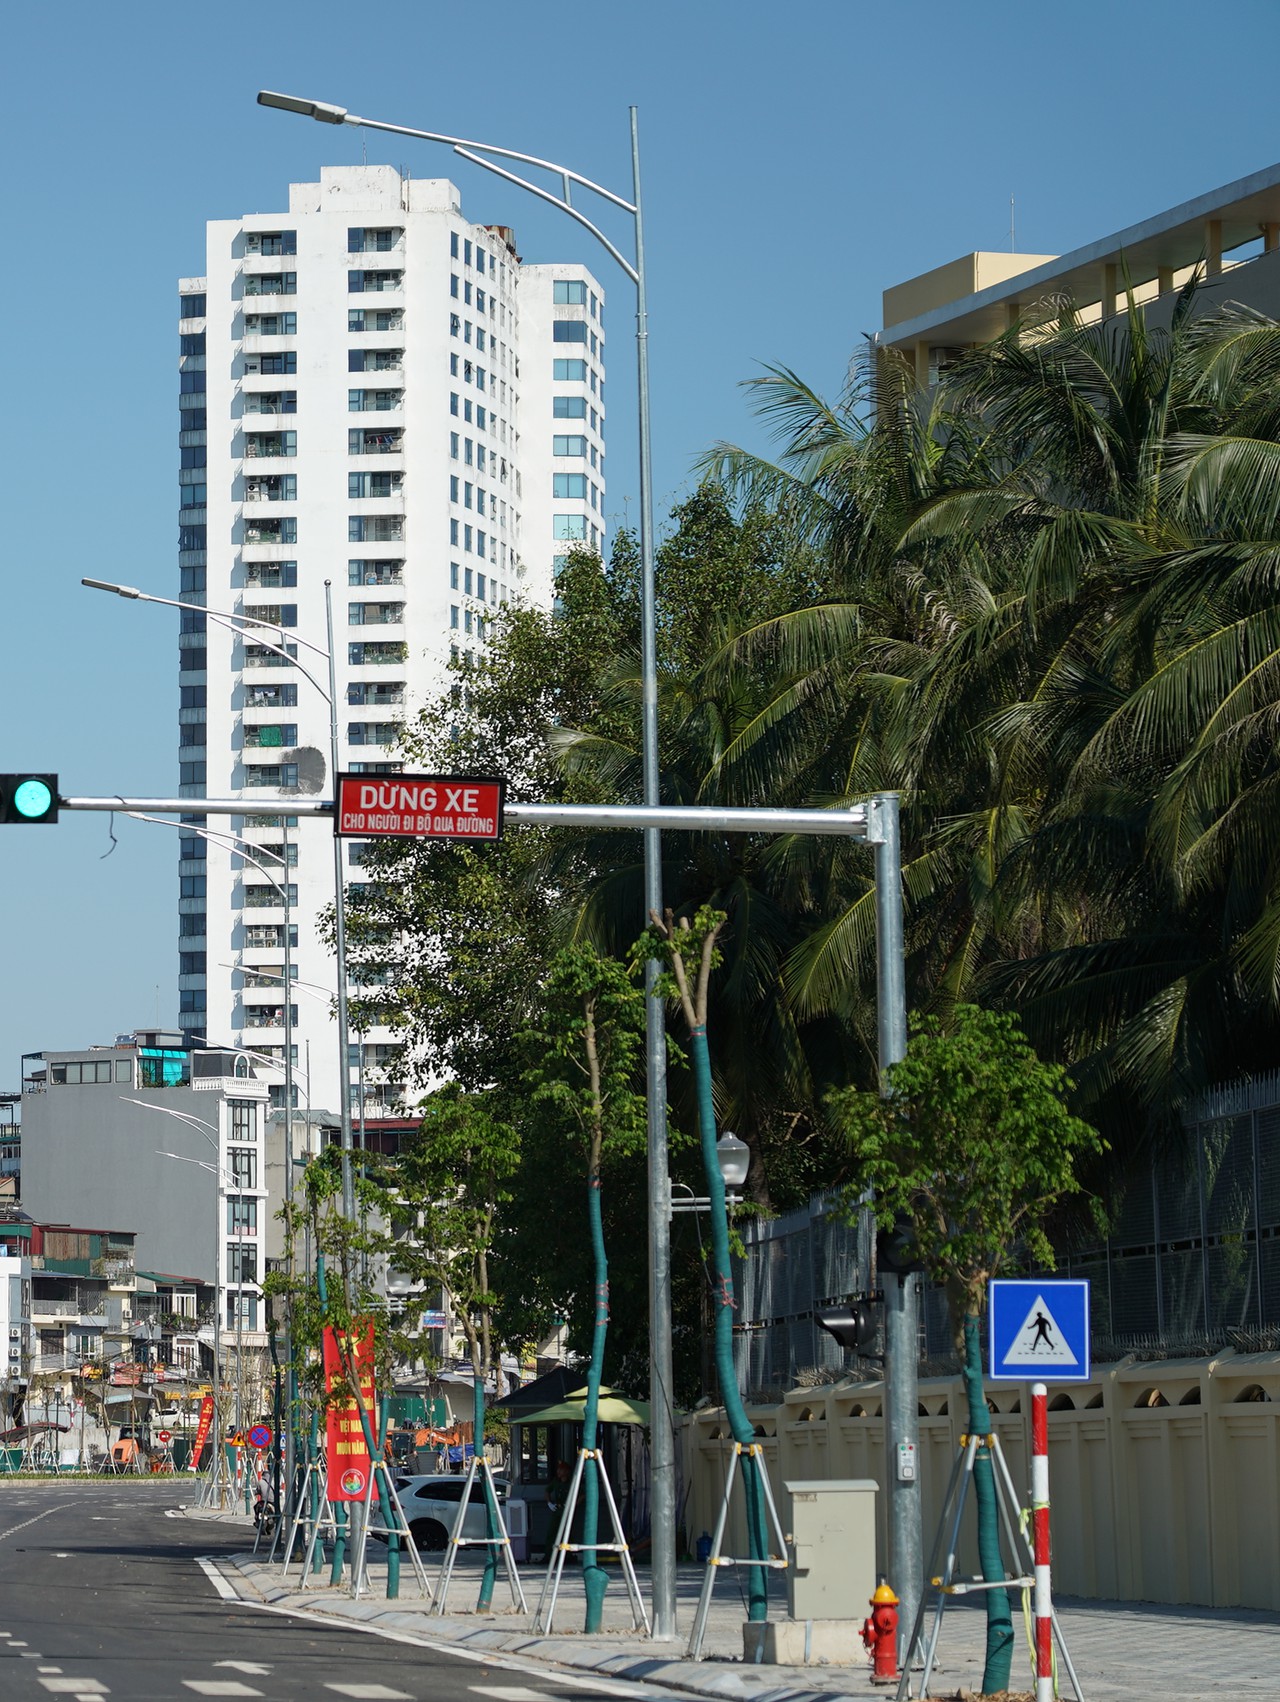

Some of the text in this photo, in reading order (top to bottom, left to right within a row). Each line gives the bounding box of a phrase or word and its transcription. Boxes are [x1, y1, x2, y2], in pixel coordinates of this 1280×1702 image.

[360, 781, 480, 813] DỪNG XE
[343, 810, 494, 835] CHO NGƯỜI ĐI BỘ QUA ĐƯỜNG
